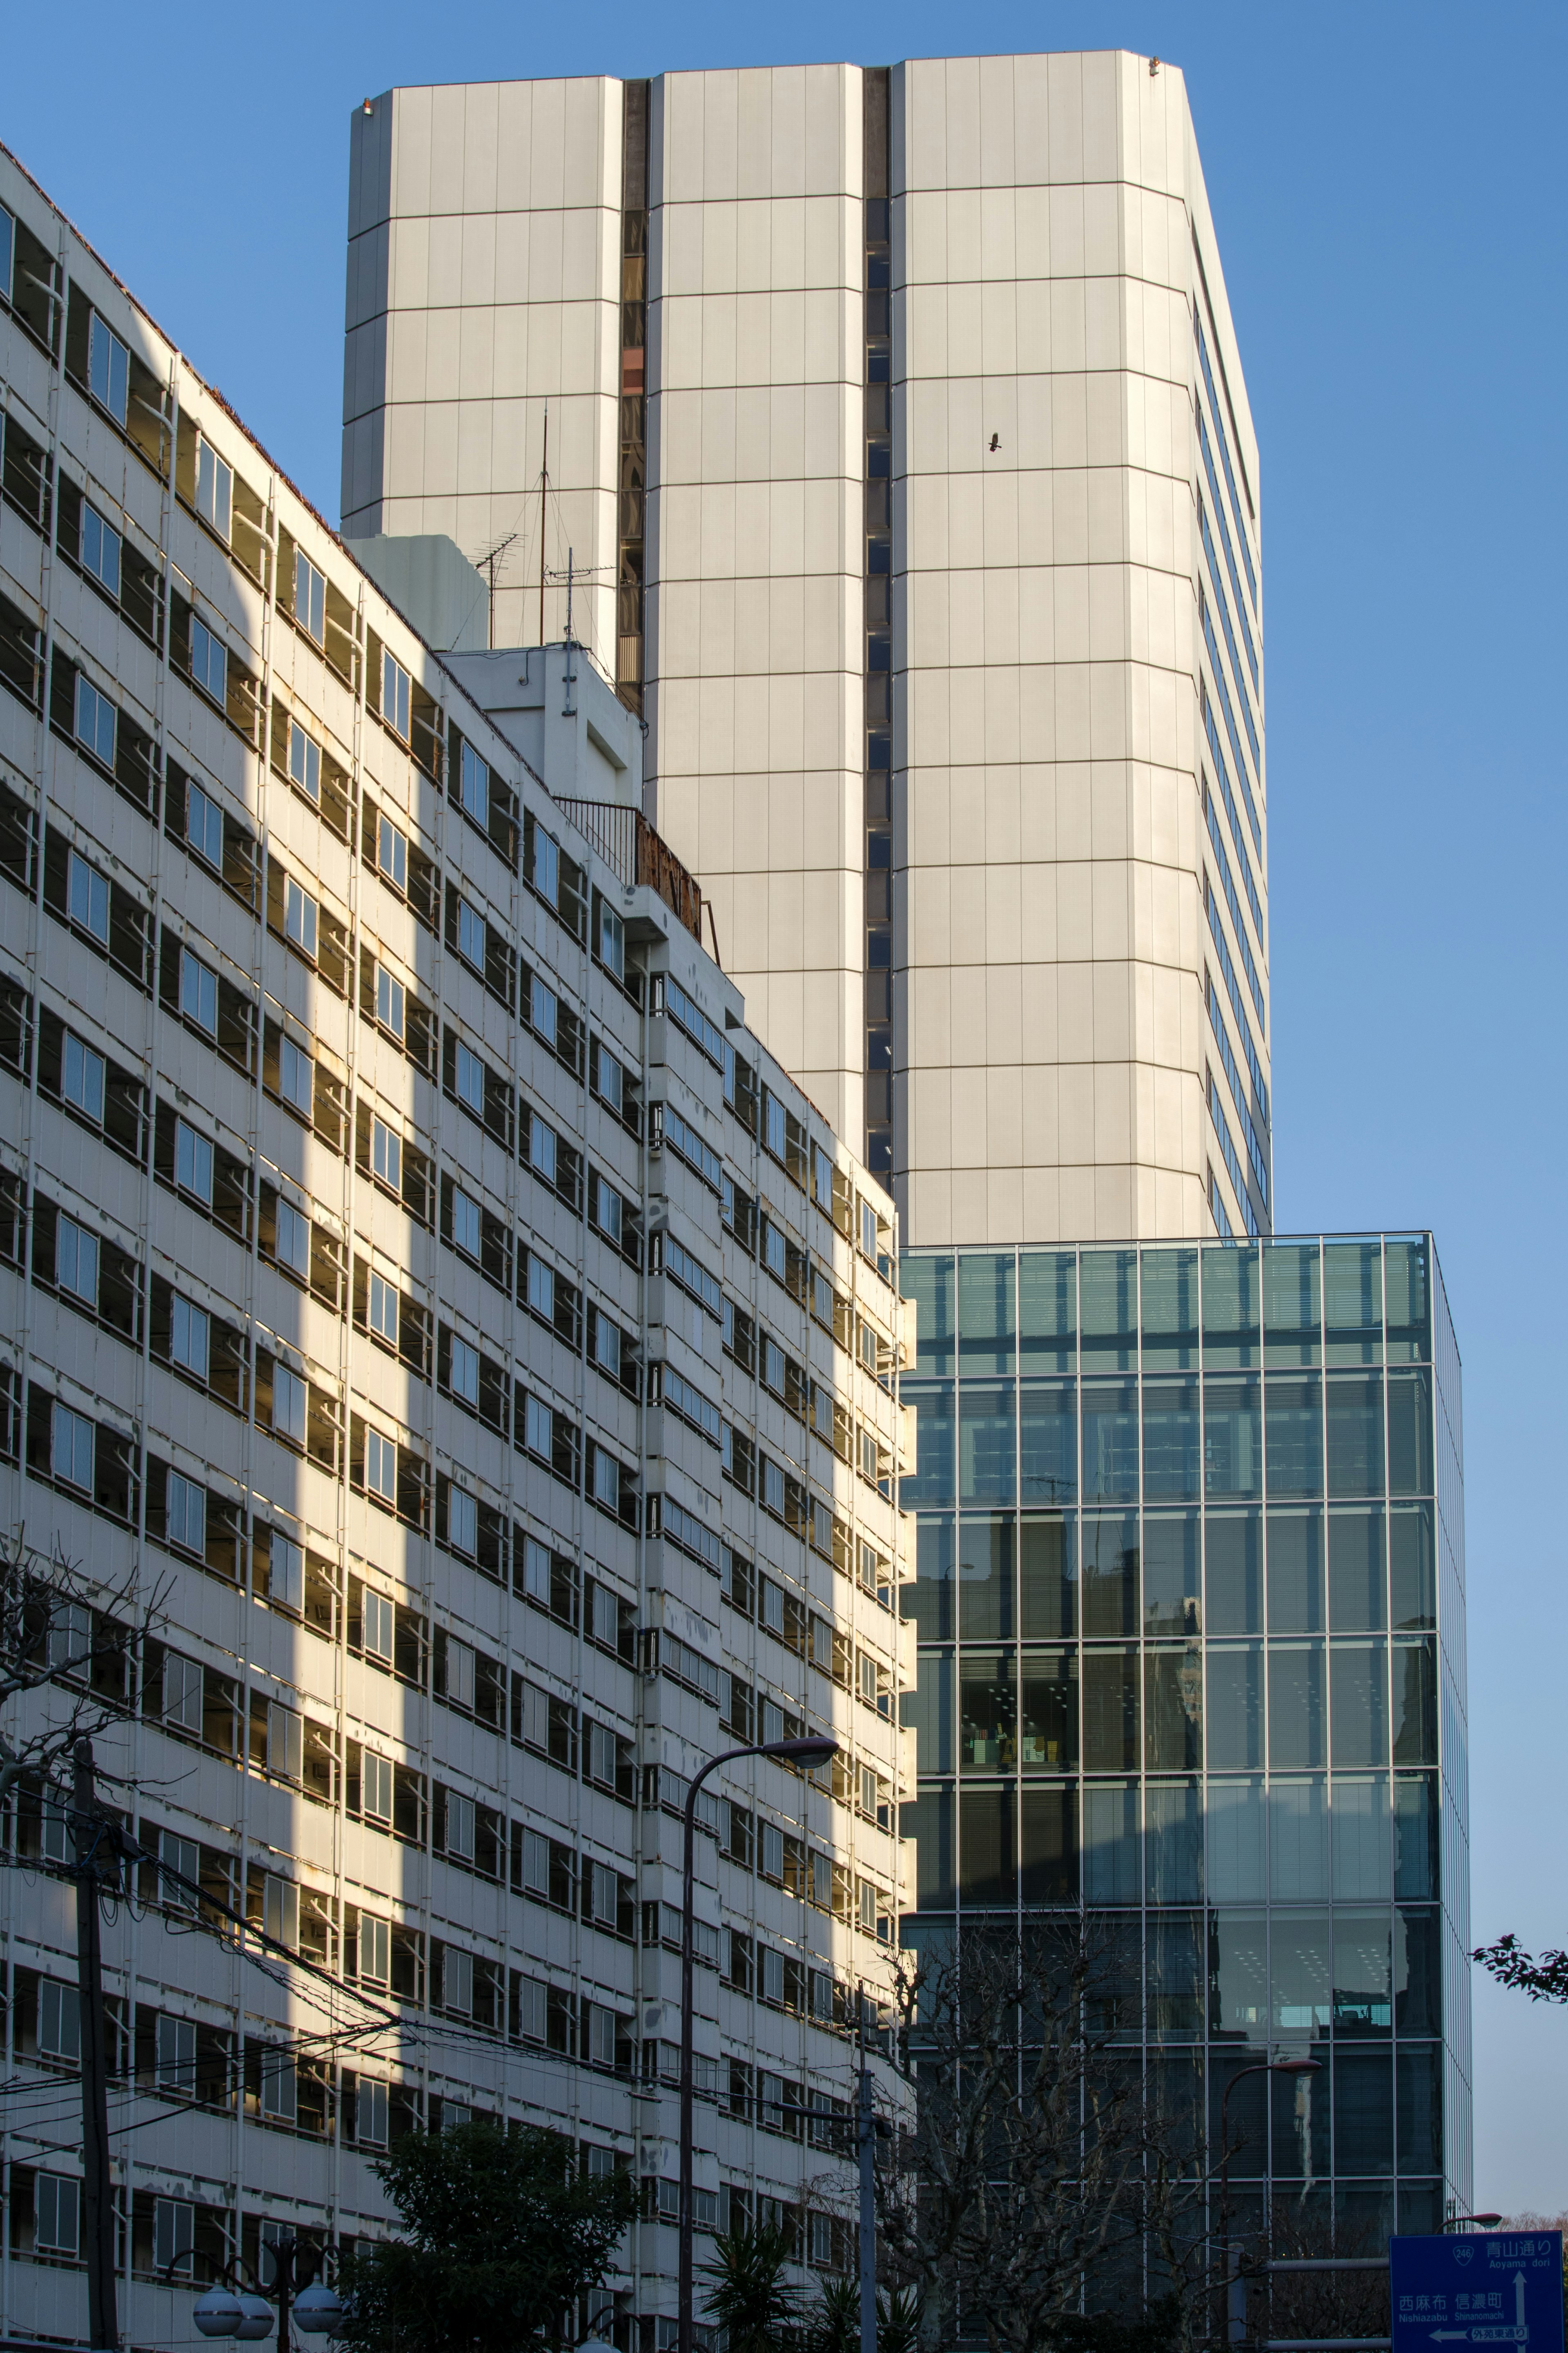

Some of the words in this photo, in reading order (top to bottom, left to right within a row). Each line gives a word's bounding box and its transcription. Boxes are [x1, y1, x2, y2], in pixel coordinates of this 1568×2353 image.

[1457, 2249, 1470, 2258] 246
[1486, 2240, 1551, 2258] 青山通り
[1489, 2260, 1526, 2270] Aoyama
[1532, 2258, 1550, 2267] dori
[1399, 2295, 1447, 2311] 西麻布
[1455, 2293, 1502, 2310] 信濃町
[1399, 2313, 1447, 2322] Nishiazabu
[1455, 2311, 1504, 2321] Shinanomachi
[1473, 2328, 1524, 2338] 外苑東通り
